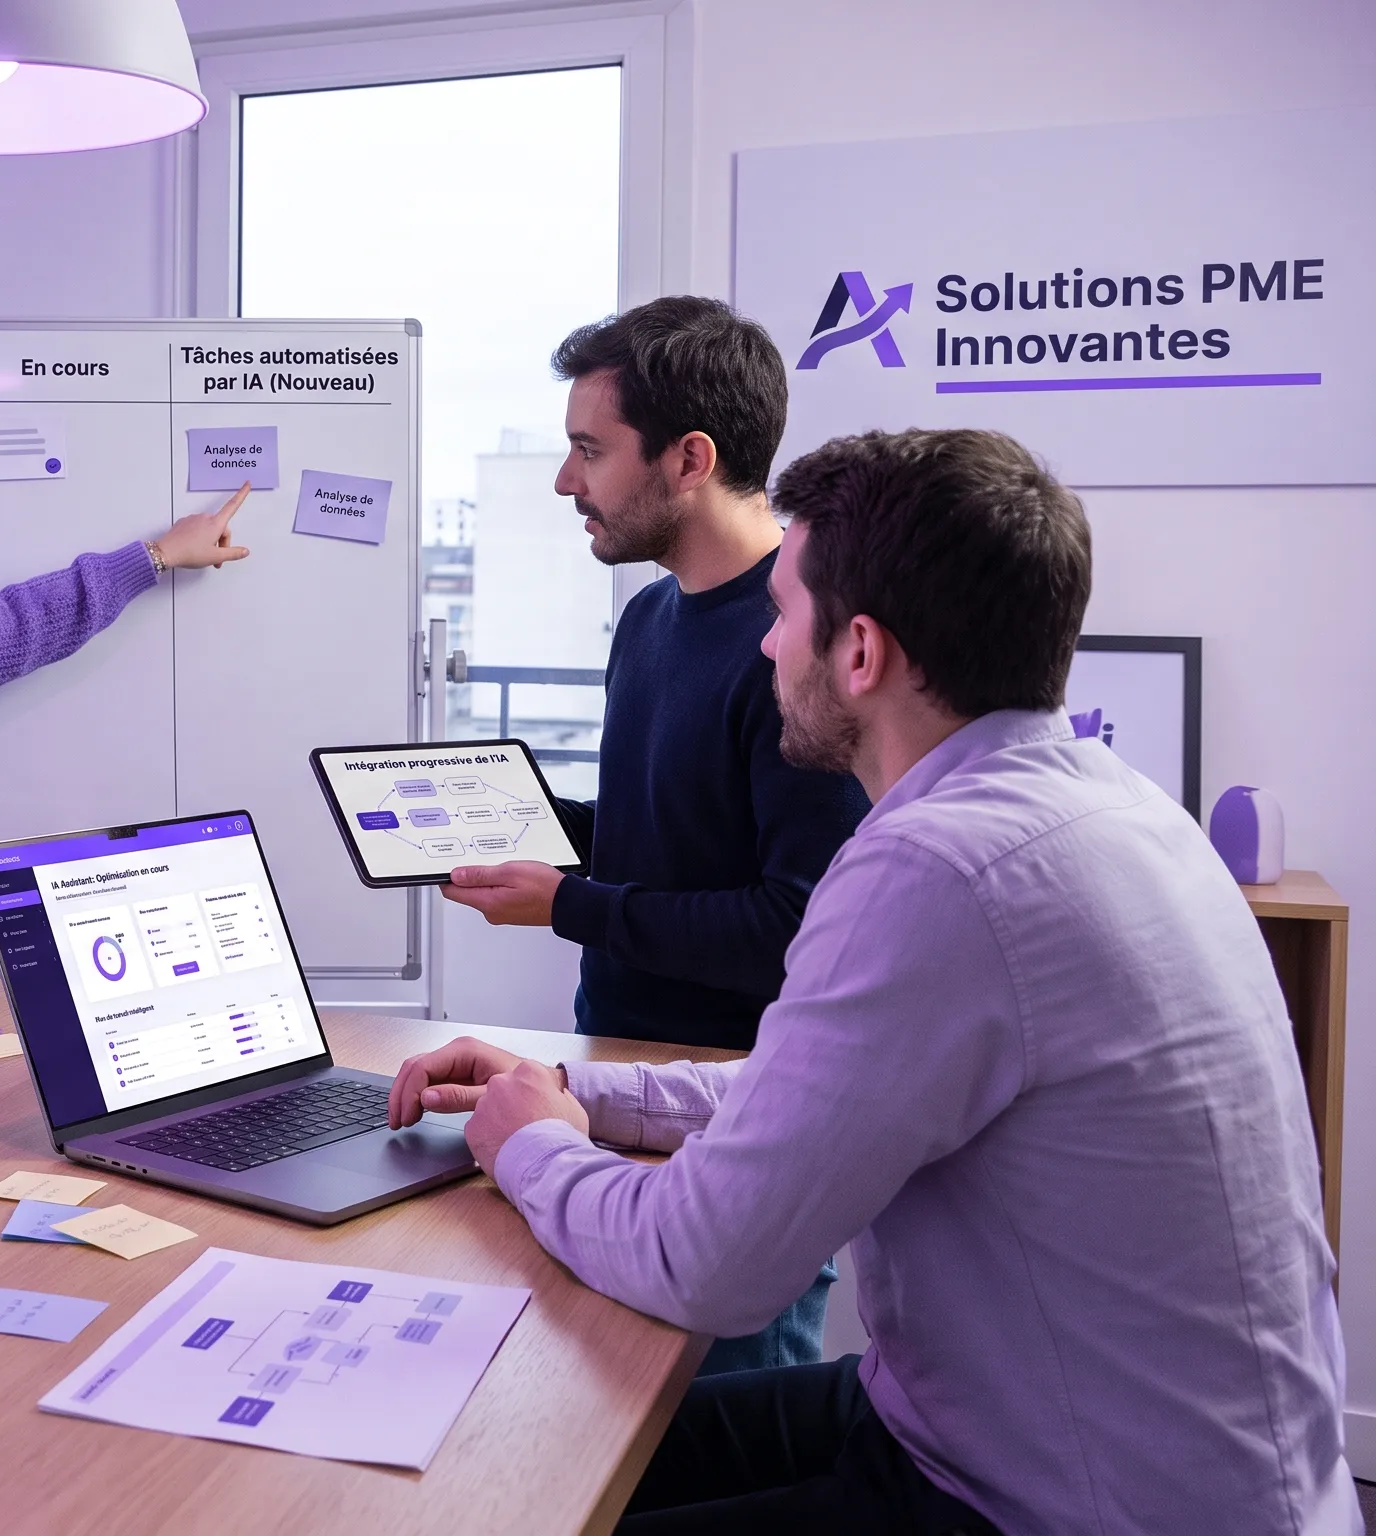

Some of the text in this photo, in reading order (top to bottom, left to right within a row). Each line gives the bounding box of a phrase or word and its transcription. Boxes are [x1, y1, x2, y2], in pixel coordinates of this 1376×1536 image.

[935, 258, 1325, 314] Solutions PME
[936, 323, 1231, 367] Innovantes
[180, 345, 399, 366] Tâches automatisées
[21, 358, 110, 377] En cours
[204, 373, 375, 395] par IA (Nouveau)
[203, 444, 263, 457] Analyse de
[314, 488, 374, 505] Analyse de
[319, 503, 366, 518] données
[344, 760, 407, 772] Intégration
[407, 755, 473, 770] progressive
[474, 754, 489, 764] de
[150, 865, 170, 874] cours
